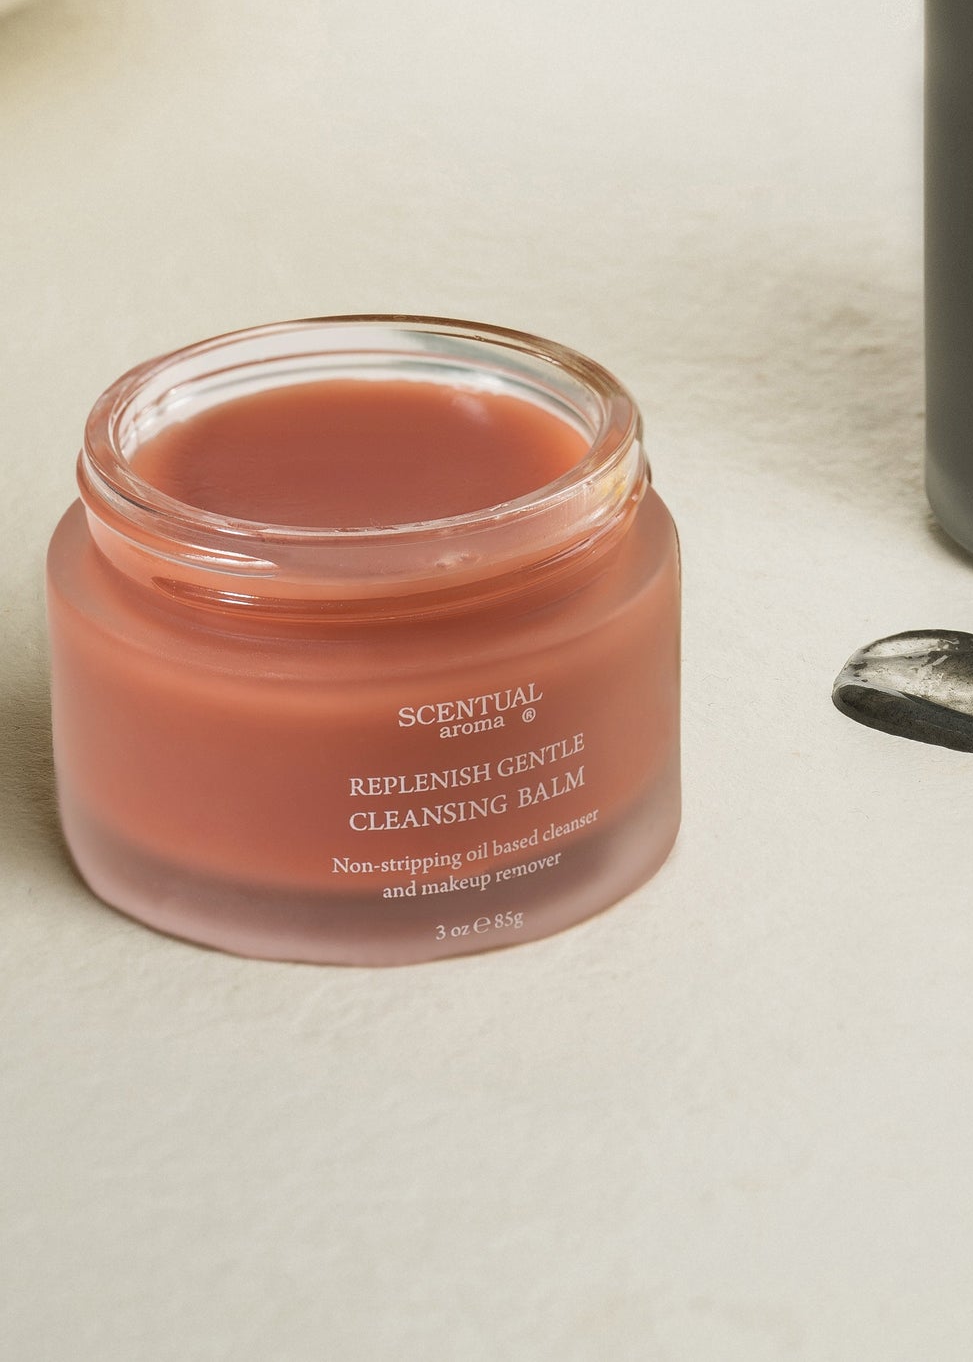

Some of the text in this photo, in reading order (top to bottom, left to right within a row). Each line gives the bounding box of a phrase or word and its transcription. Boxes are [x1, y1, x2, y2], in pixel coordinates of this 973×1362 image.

[399, 683, 543, 727] SCENTUAL
[440, 716, 505, 738] aroma
[349, 733, 584, 796] REPLENISH GENTLE
[349, 766, 585, 831] CLEANSING BALM
[332, 808, 598, 875] Non-stripping oil based cleanser
[383, 853, 561, 898] and makeup remover
[436, 925, 445, 940] 3
[451, 925, 470, 938] oz
[495, 911, 523, 928] 85g
